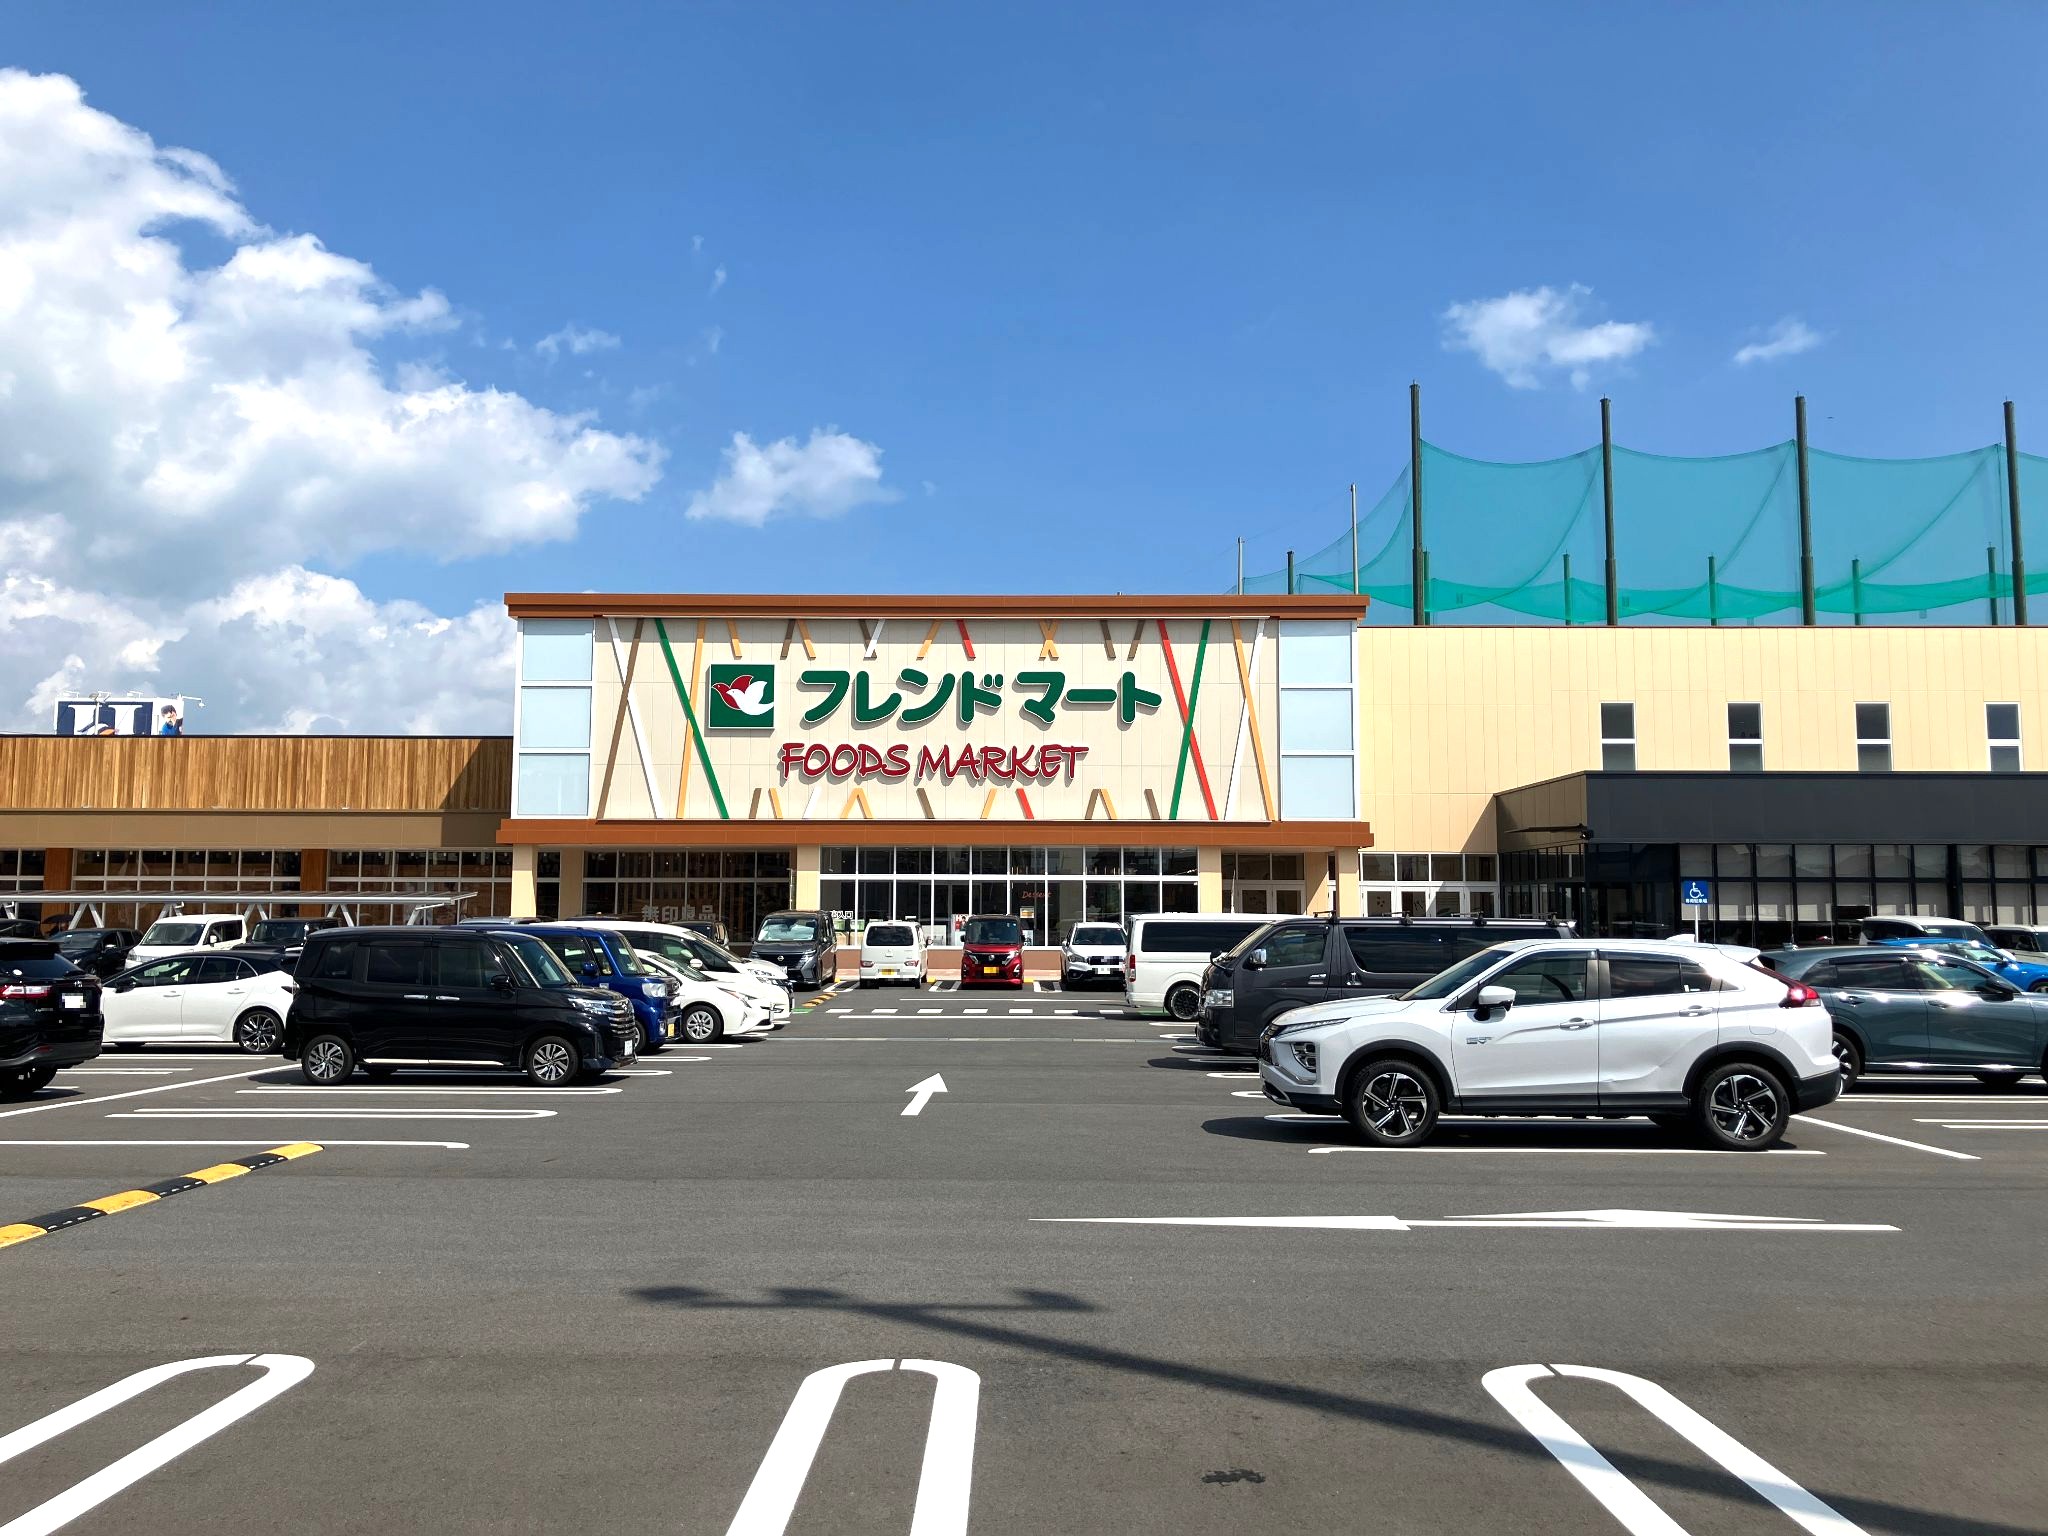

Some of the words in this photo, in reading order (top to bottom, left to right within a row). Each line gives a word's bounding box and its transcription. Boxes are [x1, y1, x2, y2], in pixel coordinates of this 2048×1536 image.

[800, 667, 1162, 724] フレンドマート
[781, 742, 912, 779] FOODS
[918, 742, 1090, 779] MARKET
